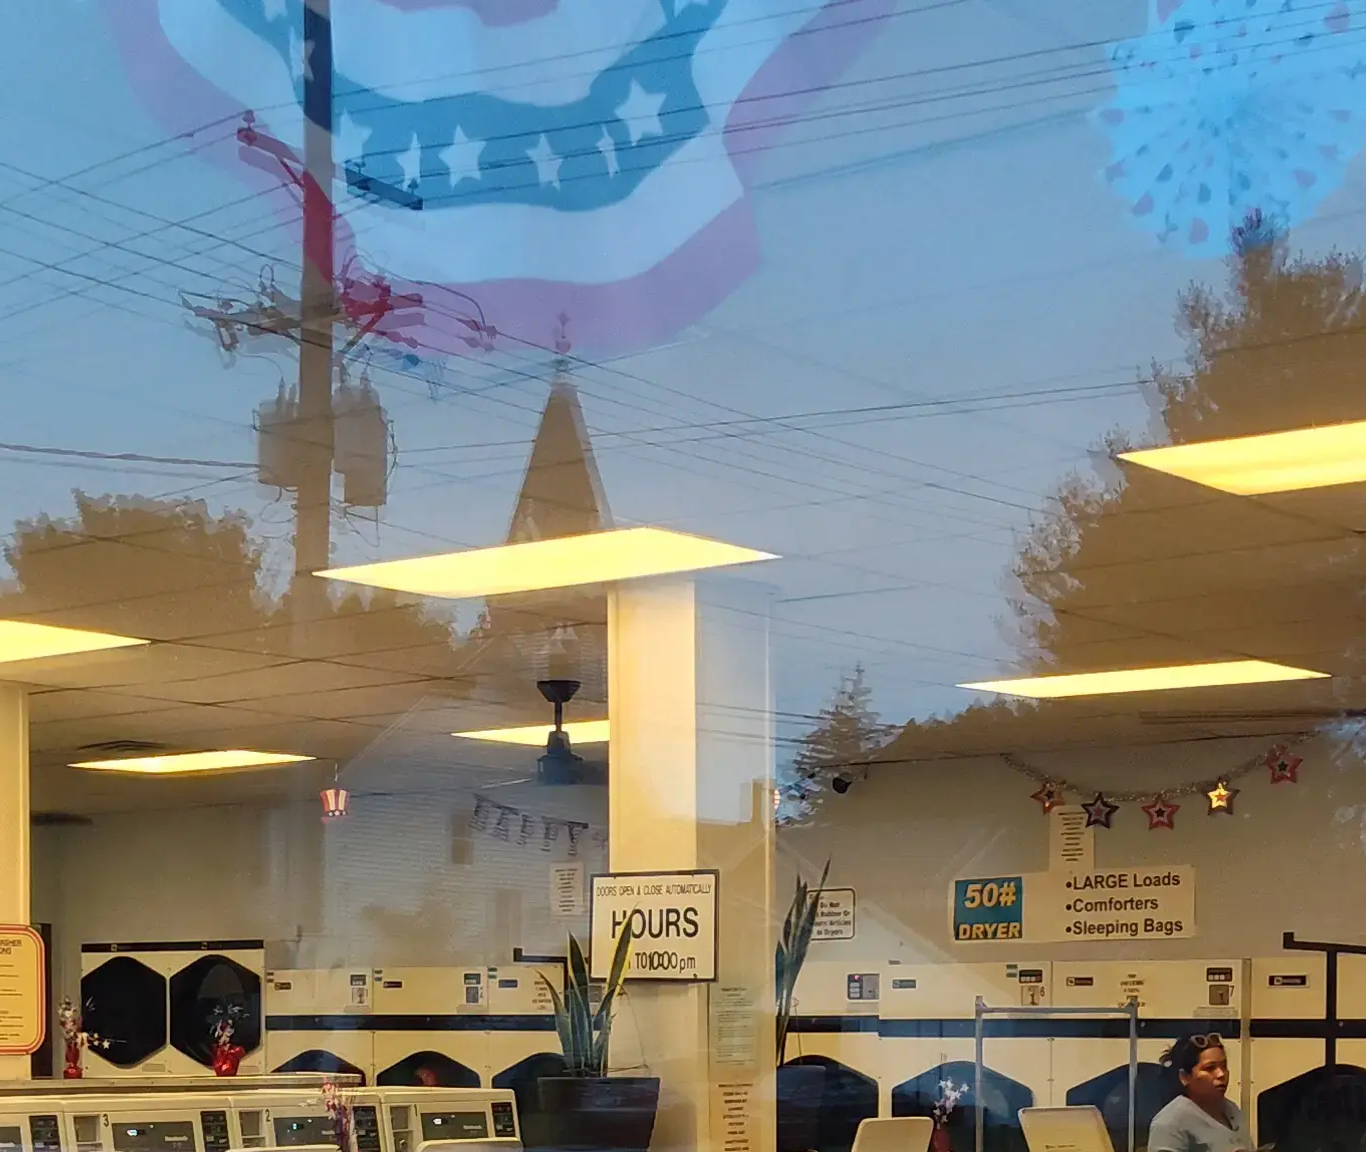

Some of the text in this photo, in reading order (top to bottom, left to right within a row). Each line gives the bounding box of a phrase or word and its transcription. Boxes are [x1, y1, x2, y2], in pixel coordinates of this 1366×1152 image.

[643, 884, 663, 896] CLOSE
[665, 883, 712, 895] AUTOMATICALLY
[1073, 872, 1181, 890] LARGE Loads
[964, 881, 1017, 909] 50#
[1073, 897, 1159, 913] Comforters
[611, 907, 699, 939] HOURS
[958, 923, 1021, 940] DRYER
[1073, 918, 1184, 937] Sleeping Bags
[679, 956, 697, 975] pm
[102, 1113, 110, 1128] 3
[265, 1109, 272, 1123] 2
